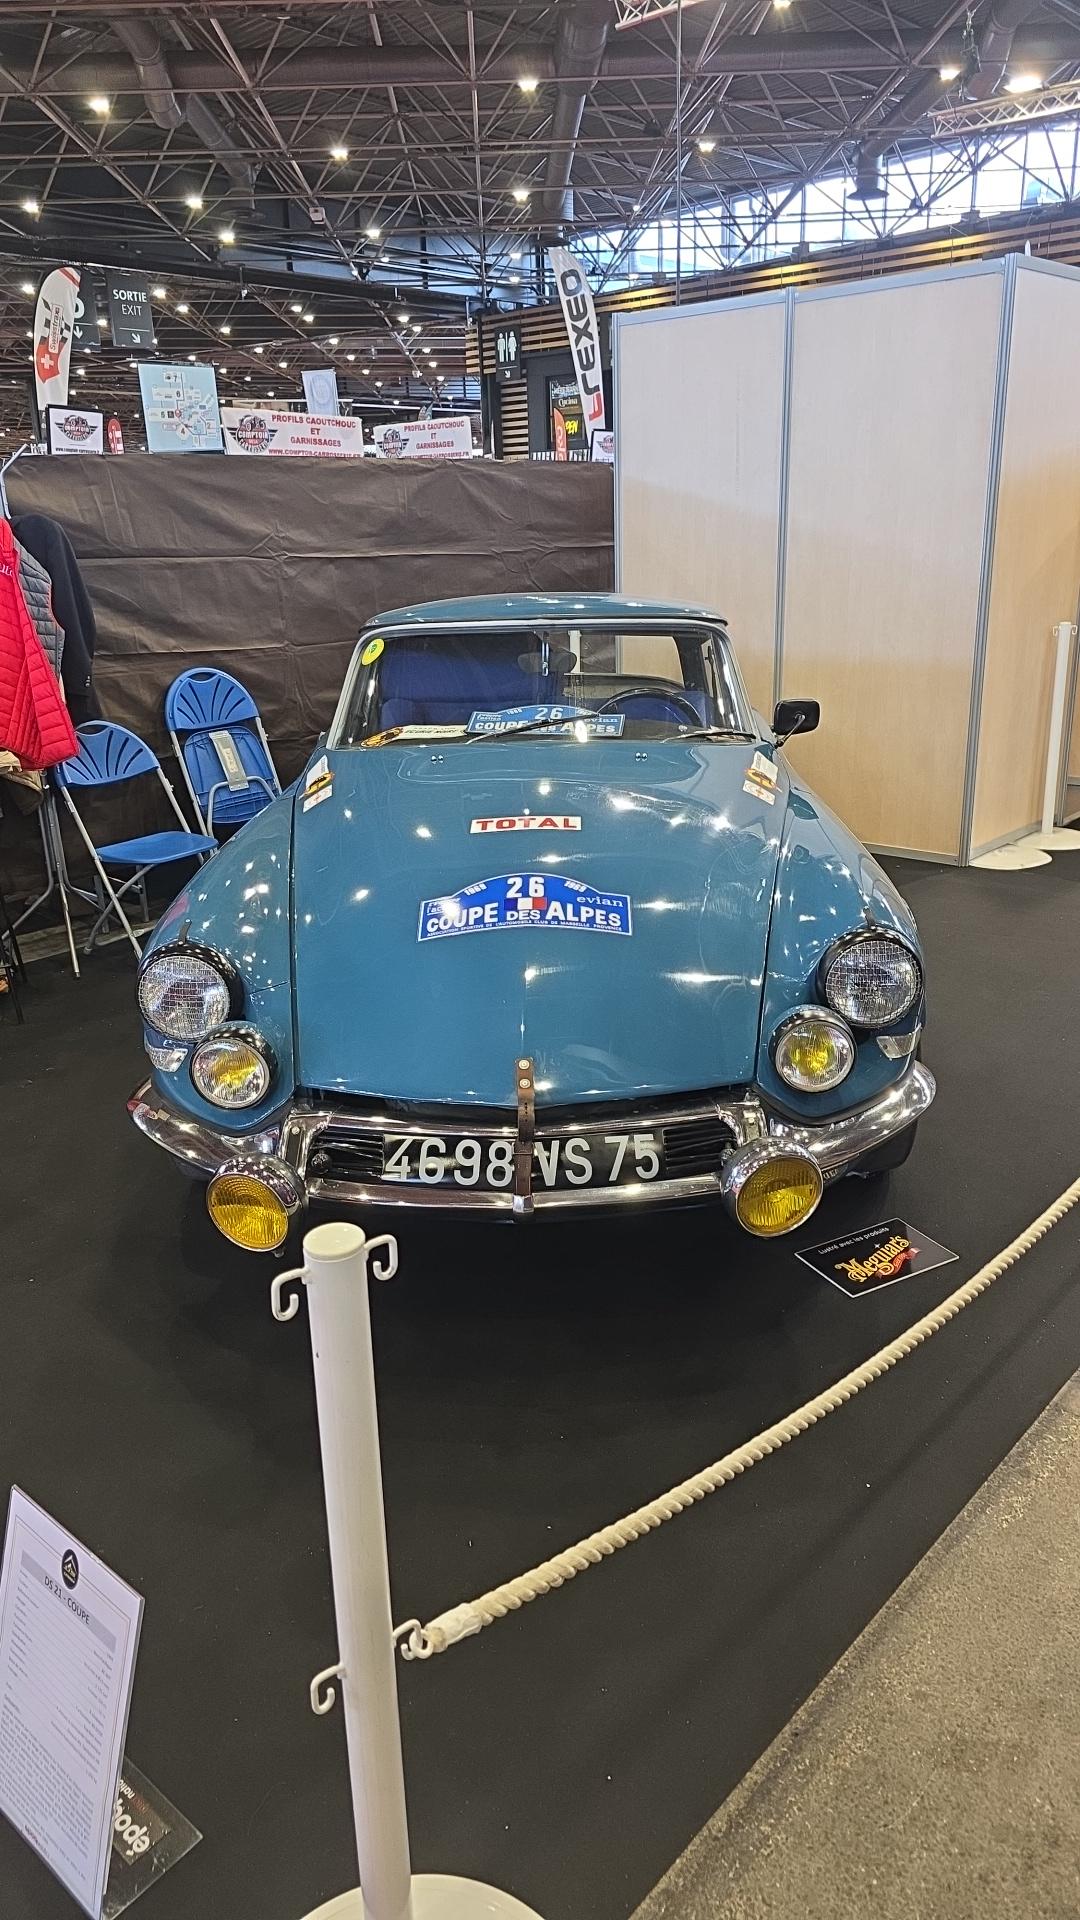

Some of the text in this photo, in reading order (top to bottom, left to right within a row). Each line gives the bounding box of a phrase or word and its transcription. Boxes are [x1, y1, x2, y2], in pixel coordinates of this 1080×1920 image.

[112, 288, 148, 303] SORTIE
[121, 303, 143, 317] EXIT
[271, 413, 357, 428] PROFILS CAOUTCHOUC
[403, 420, 465, 433] PROFILS CAOUTCHOUC
[310, 427, 321, 435] ET
[430, 432, 437, 440] ET
[290, 436, 342, 448] GARNISSAGES
[415, 440, 455, 450] GARNISSAGES
[535, 707, 564, 720] 26
[476, 817, 578, 831] TOTAL
[506, 876, 545, 898] 26
[576, 896, 624, 908] evian
[426, 902, 499, 933] COUPE
[506, 909, 541, 921] DES
[545, 900, 622, 927] ALPES
[593, 923, 622, 931] PROVENCE
[385, 1133, 660, 1187] 4698 VS 75
[44, 1575, 53, 1591] DS
[54, 1585, 63, 1600] 21
[67, 1597, 91, 1625] COUPE
